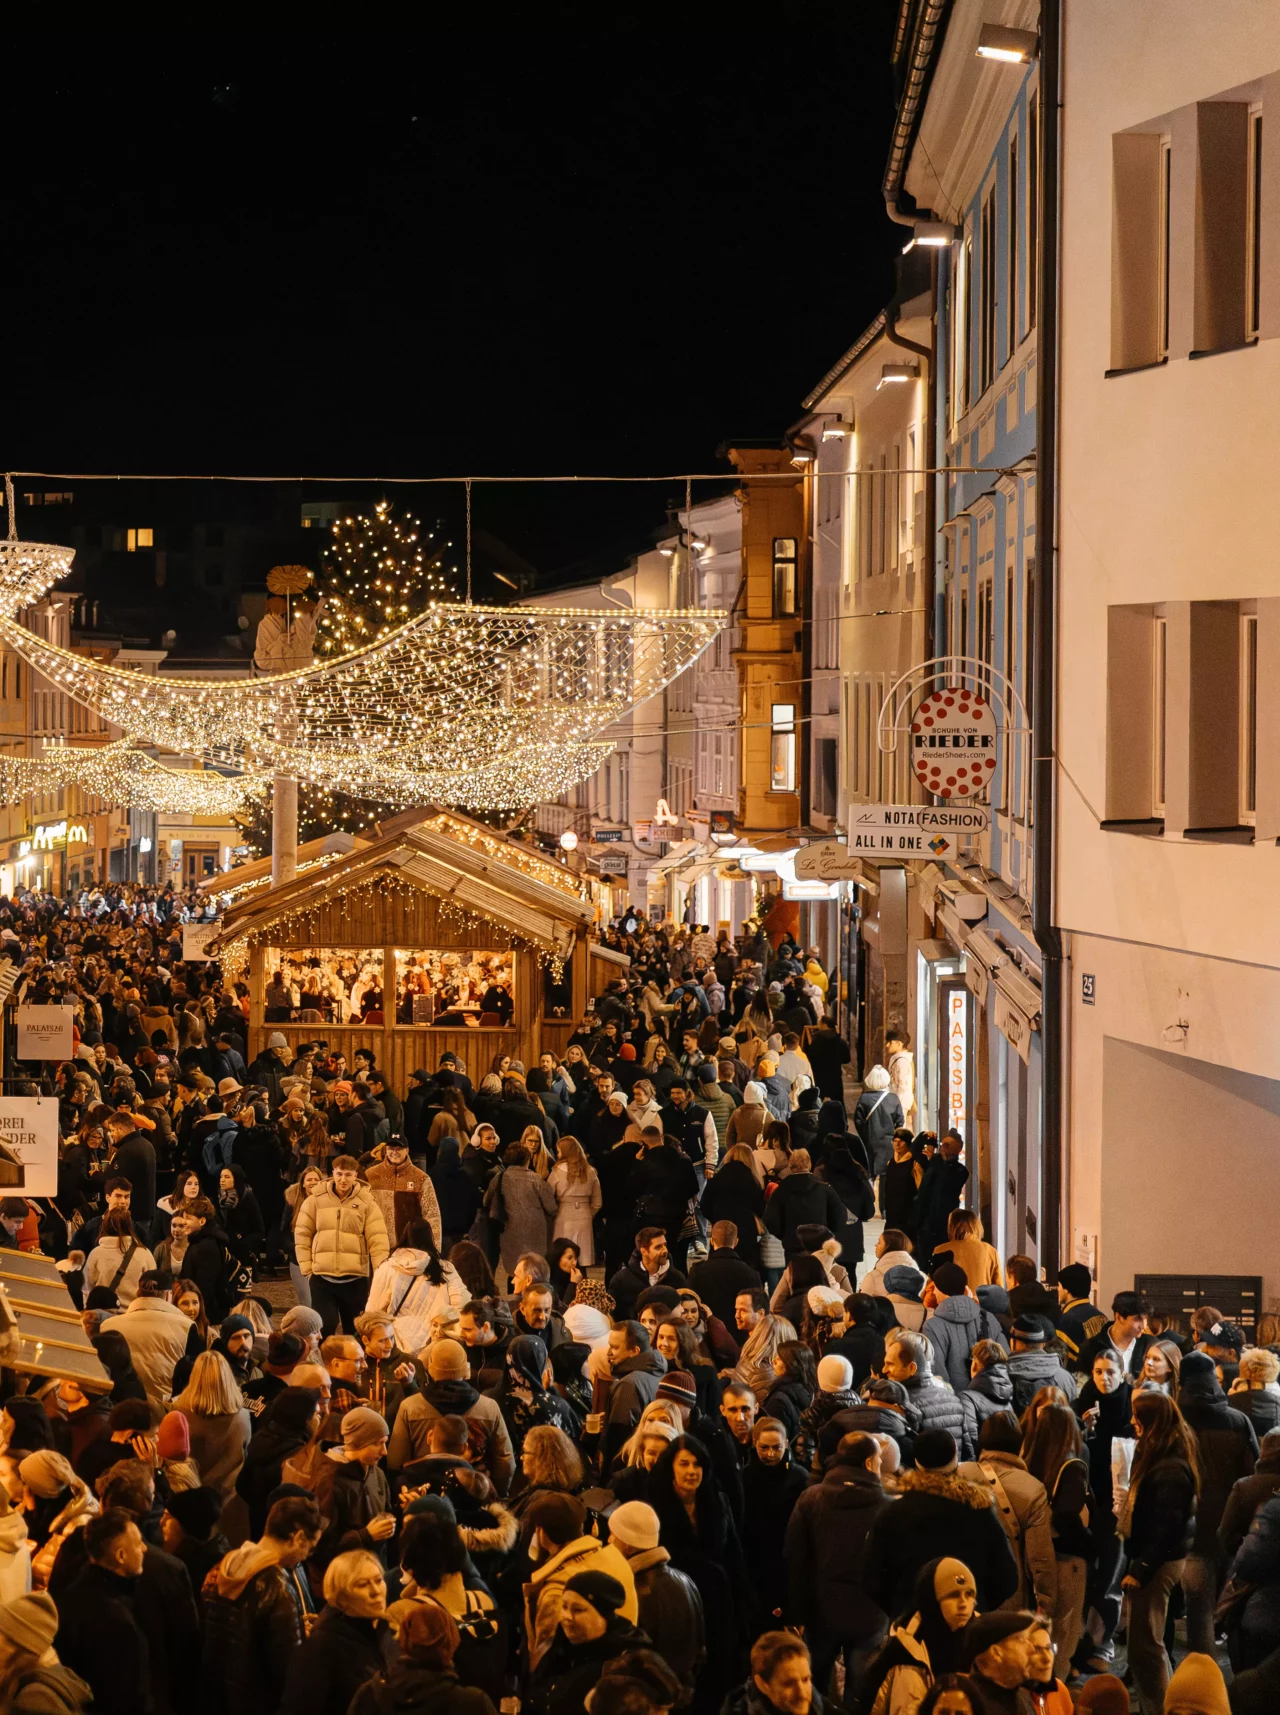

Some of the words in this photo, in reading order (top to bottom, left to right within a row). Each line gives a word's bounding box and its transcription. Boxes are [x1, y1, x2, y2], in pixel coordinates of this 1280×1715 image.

[915, 735, 994, 748] RIEDER
[922, 813, 982, 827] FASHION
[855, 835, 876, 848] ALL
[881, 836, 893, 848] IN
[899, 836, 922, 849] ONE
[1083, 976, 1093, 995] 25
[26, 1024, 64, 1032] PALAIS26
